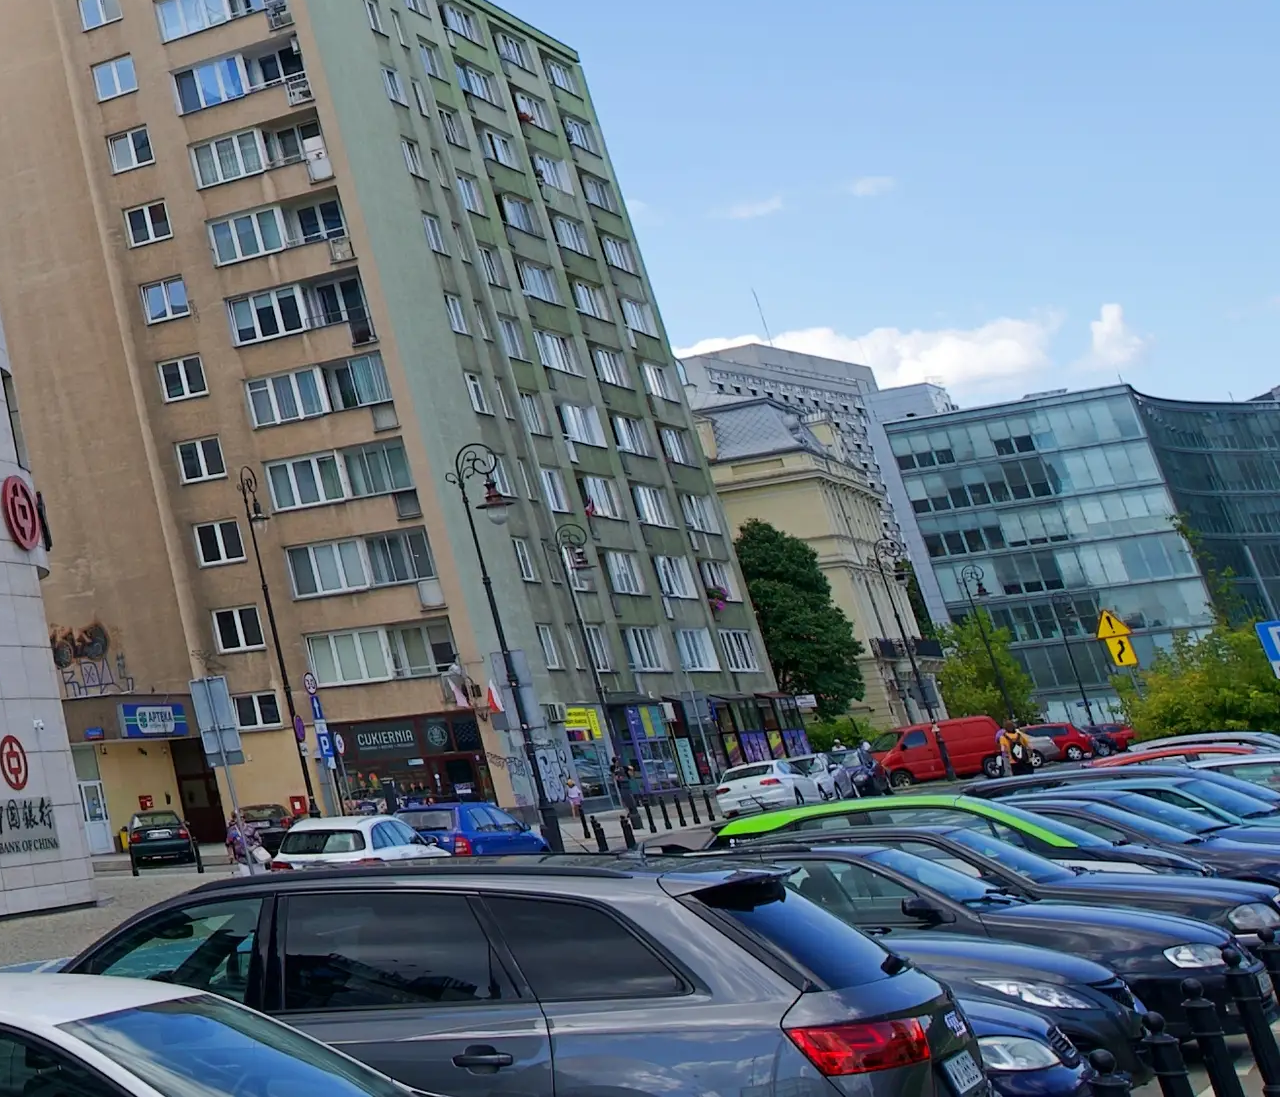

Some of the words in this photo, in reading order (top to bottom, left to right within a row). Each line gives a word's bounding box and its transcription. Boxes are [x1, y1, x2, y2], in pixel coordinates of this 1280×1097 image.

[148, 711, 173, 722] APTEKA
[357, 729, 414, 746] CUKIERNIA
[22, 839, 32, 852] OF
[33, 837, 59, 851] CHINA
